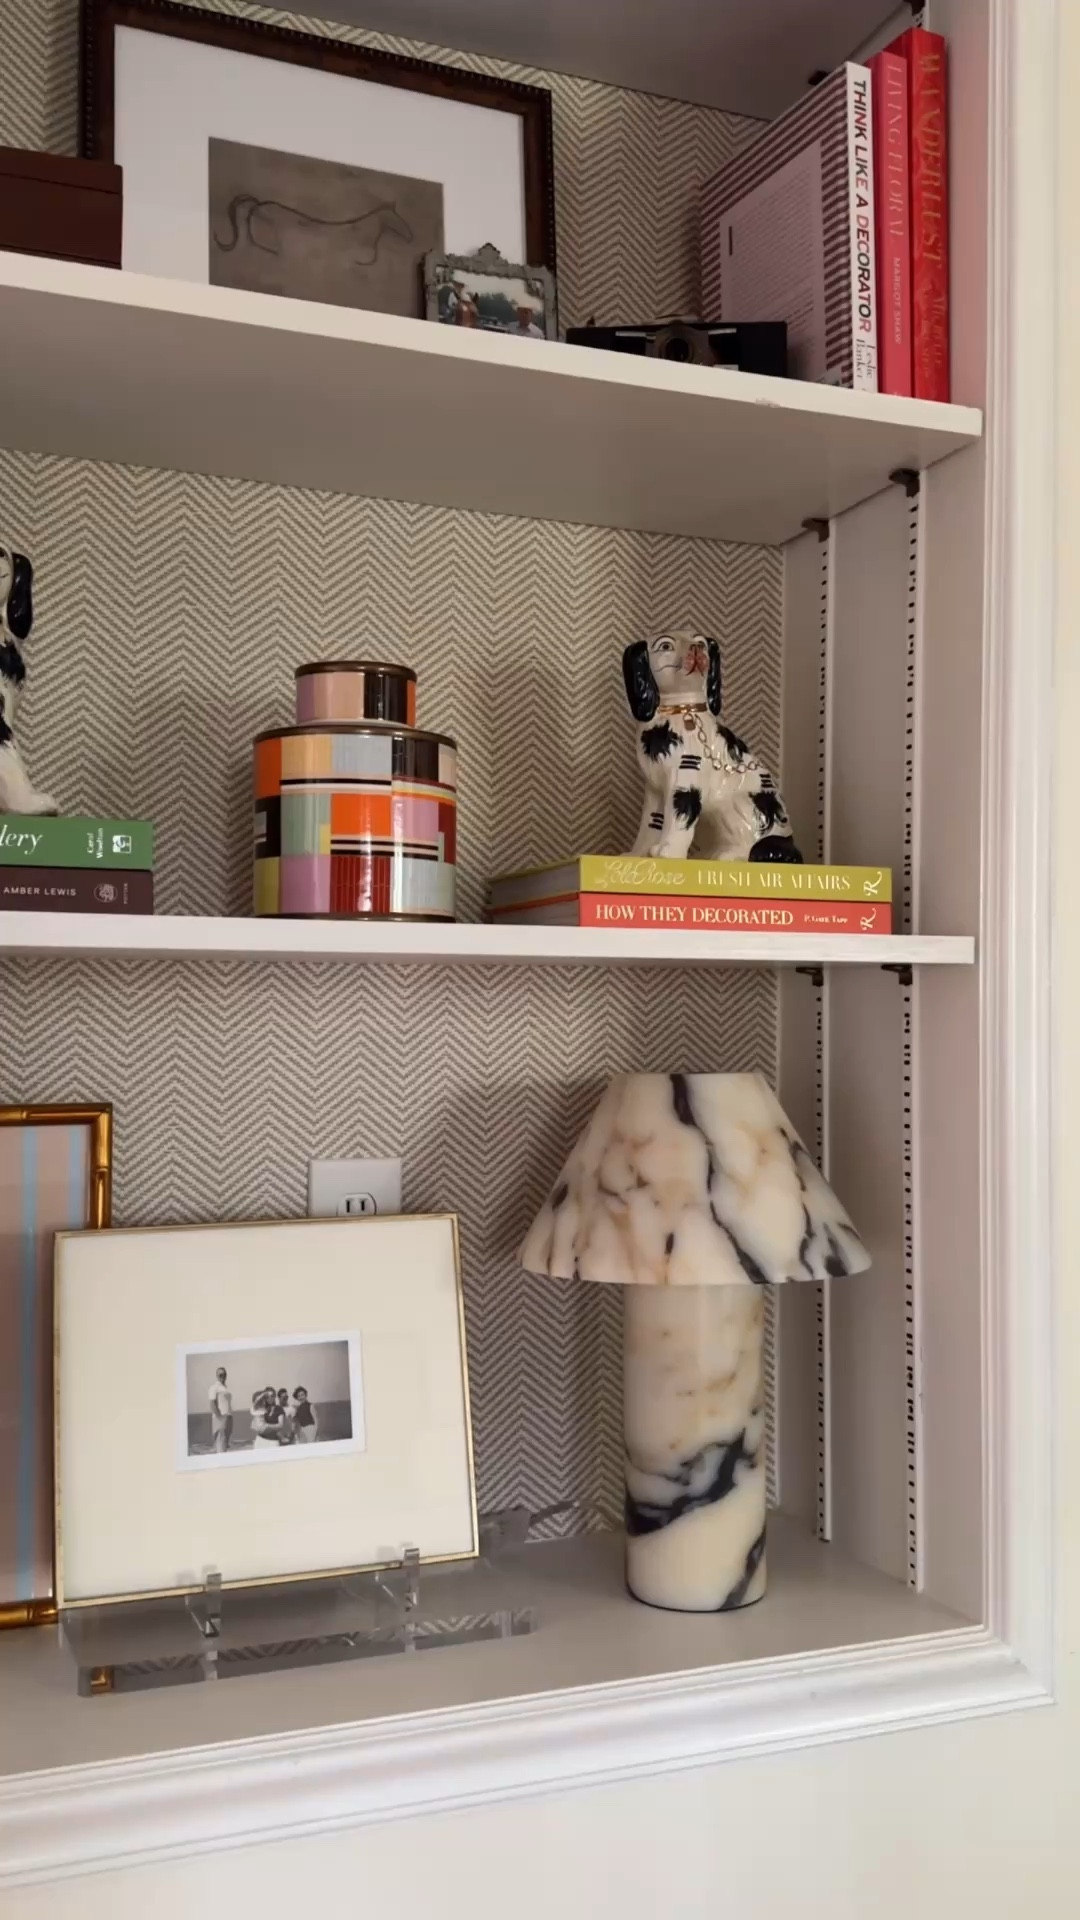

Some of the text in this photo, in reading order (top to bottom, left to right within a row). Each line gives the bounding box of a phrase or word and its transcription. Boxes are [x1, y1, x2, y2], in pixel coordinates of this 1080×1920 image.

[887, 65, 904, 240] LIVING FLORAL
[920, 53, 942, 269] WANDERLUST
[853, 80, 872, 334] THINK LIKE A DECORATOR
[893, 257, 903, 344] MARGOT SHAW
[856, 338, 866, 378] Banker
[3, 886, 77, 896] AMBER LEWIS
[697, 869, 751, 887] FRESH
[759, 872, 783, 888] AIR
[791, 873, 851, 890] AFFAIRS
[596, 903, 794, 926] HOW THEY DECORATED
